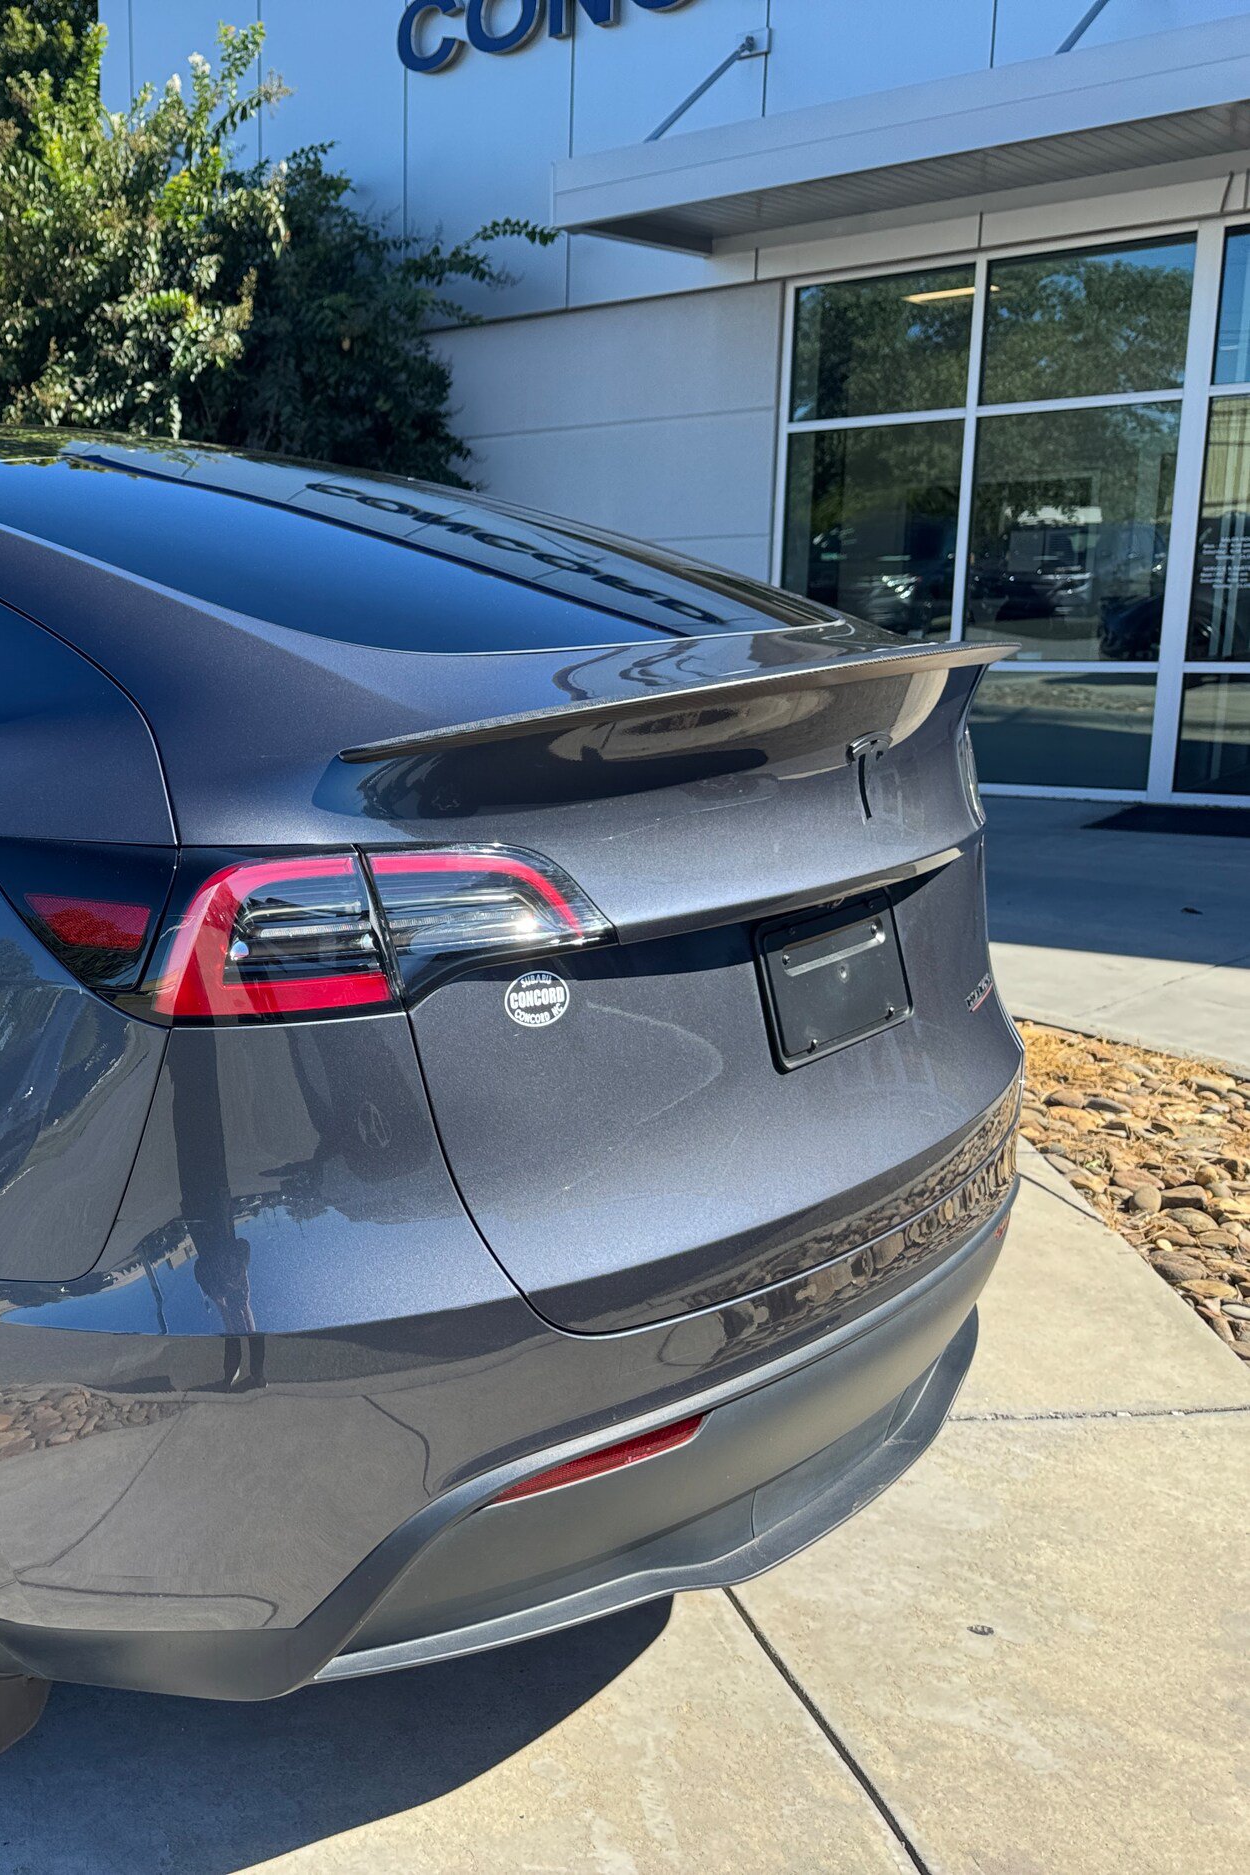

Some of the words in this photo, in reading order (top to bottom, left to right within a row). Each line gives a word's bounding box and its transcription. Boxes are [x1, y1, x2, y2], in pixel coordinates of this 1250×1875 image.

[398, 0, 688, 72] CO
[520, 974, 552, 988] SUBARU
[510, 986, 565, 1009] CONCORD
[514, 1009, 550, 1023] CONCORD
[551, 1003, 563, 1017] NC
